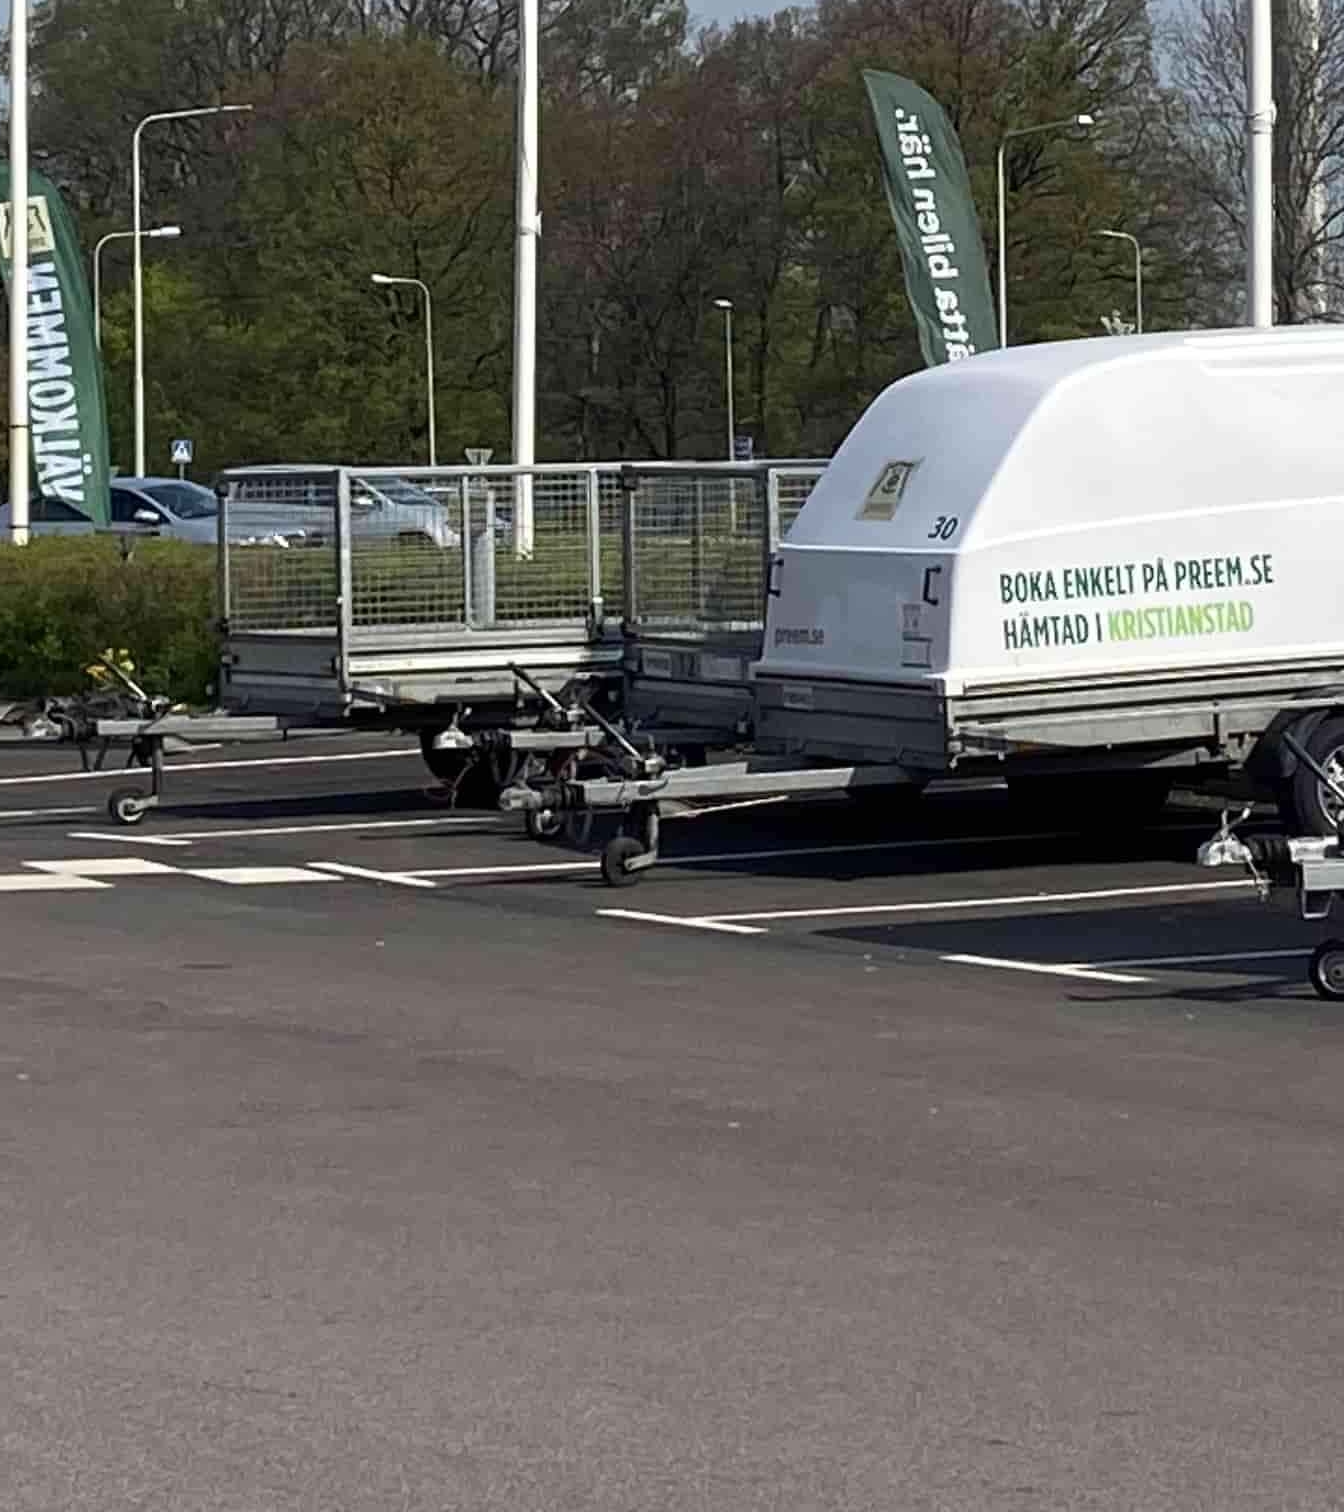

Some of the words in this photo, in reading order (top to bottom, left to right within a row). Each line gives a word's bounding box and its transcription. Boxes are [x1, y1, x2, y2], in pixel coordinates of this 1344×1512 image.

[927, 515, 959, 541] 30
[1000, 570, 1059, 604] BOKA
[1063, 564, 1135, 599] ENKELT
[1143, 557, 1169, 593] PÅ
[1175, 553, 1275, 591] PREEM.SE
[1004, 611, 1089, 650] HÄMTAD
[1096, 612, 1103, 643] I
[1108, 601, 1255, 641] KRISTIANSTAD
